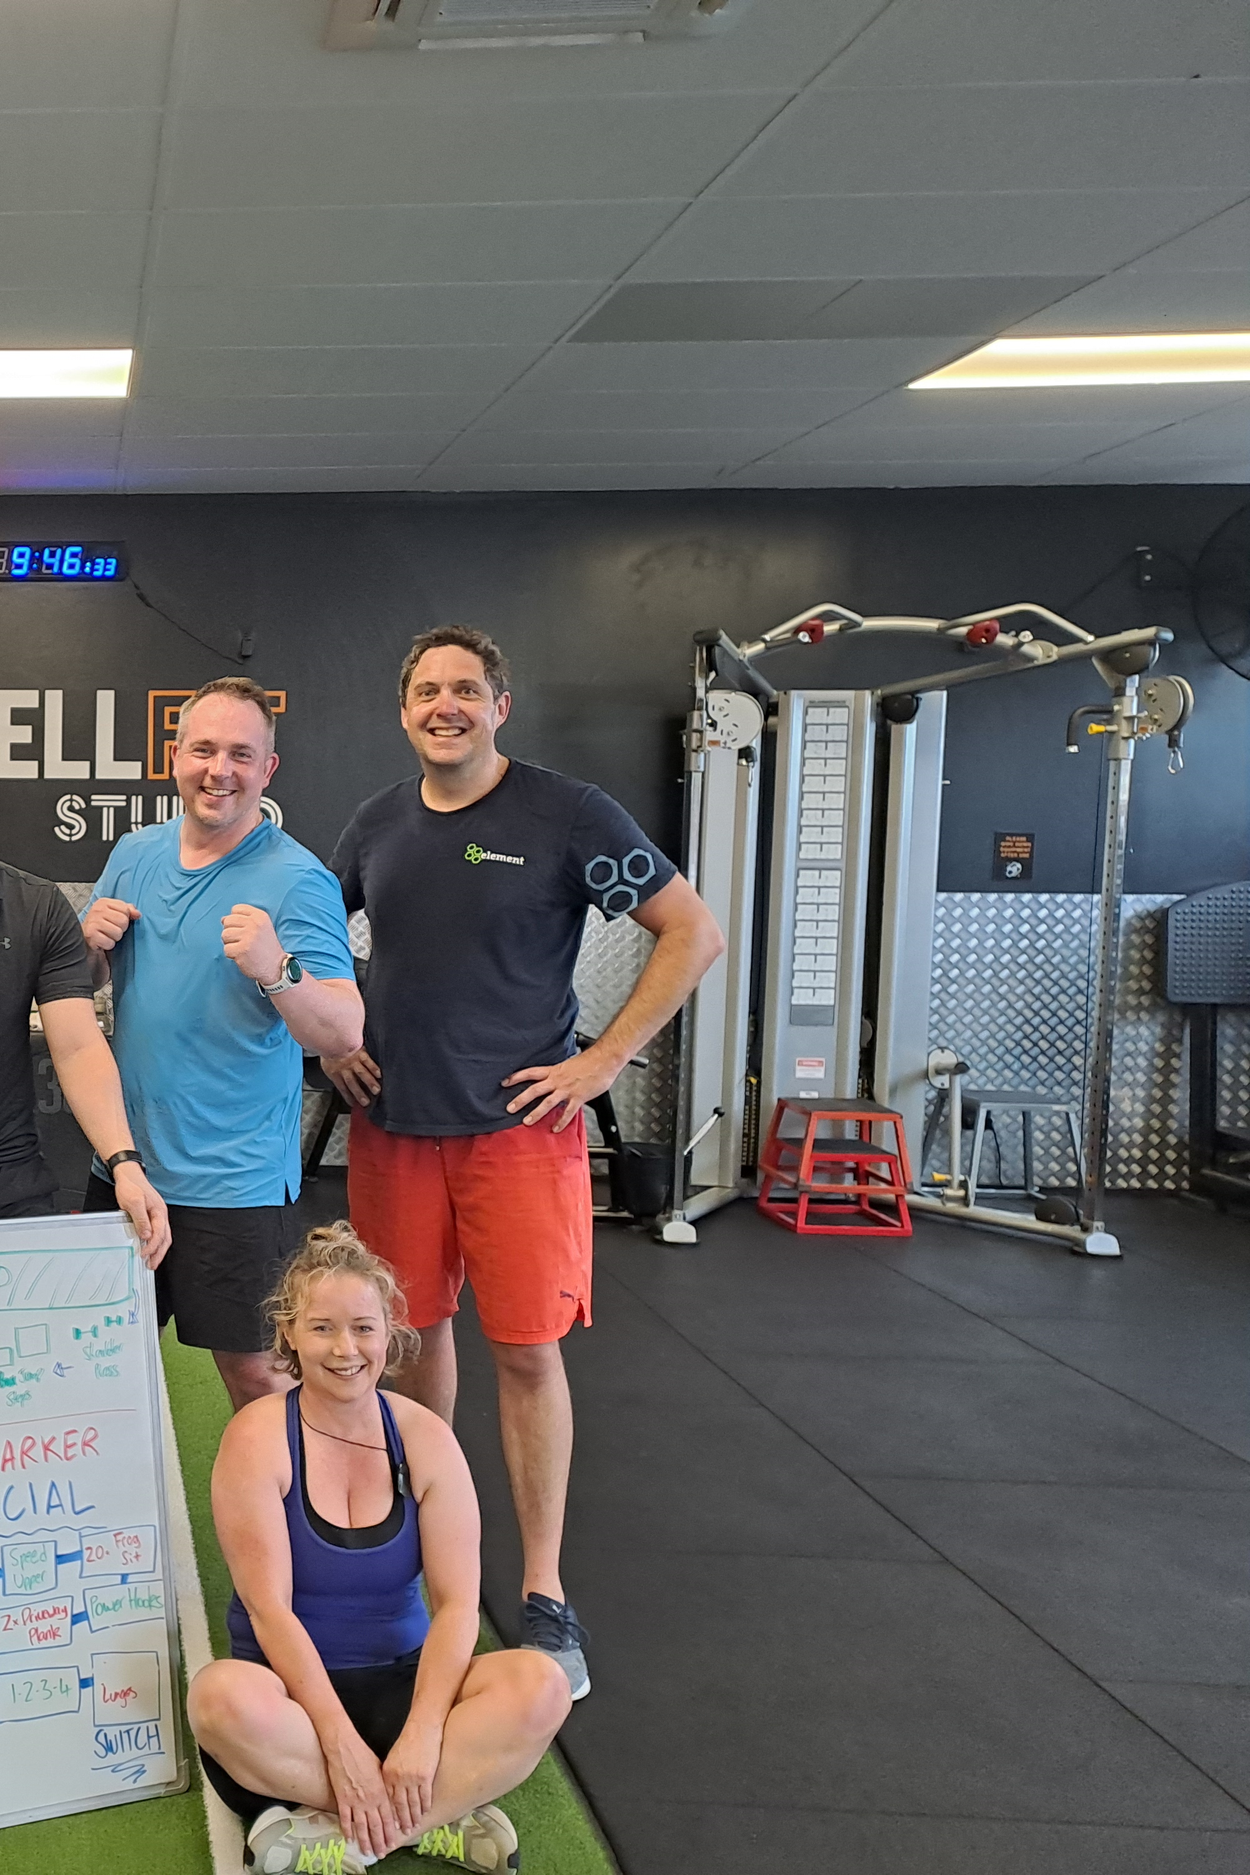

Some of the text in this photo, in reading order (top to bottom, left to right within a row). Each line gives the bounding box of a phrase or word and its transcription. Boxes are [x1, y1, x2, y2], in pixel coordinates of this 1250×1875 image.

[481, 850, 525, 866] element
[13, 1570, 47, 1591] Upper
[28, 1624, 62, 1646] Plank
[94, 1724, 162, 1760] SWITCH
